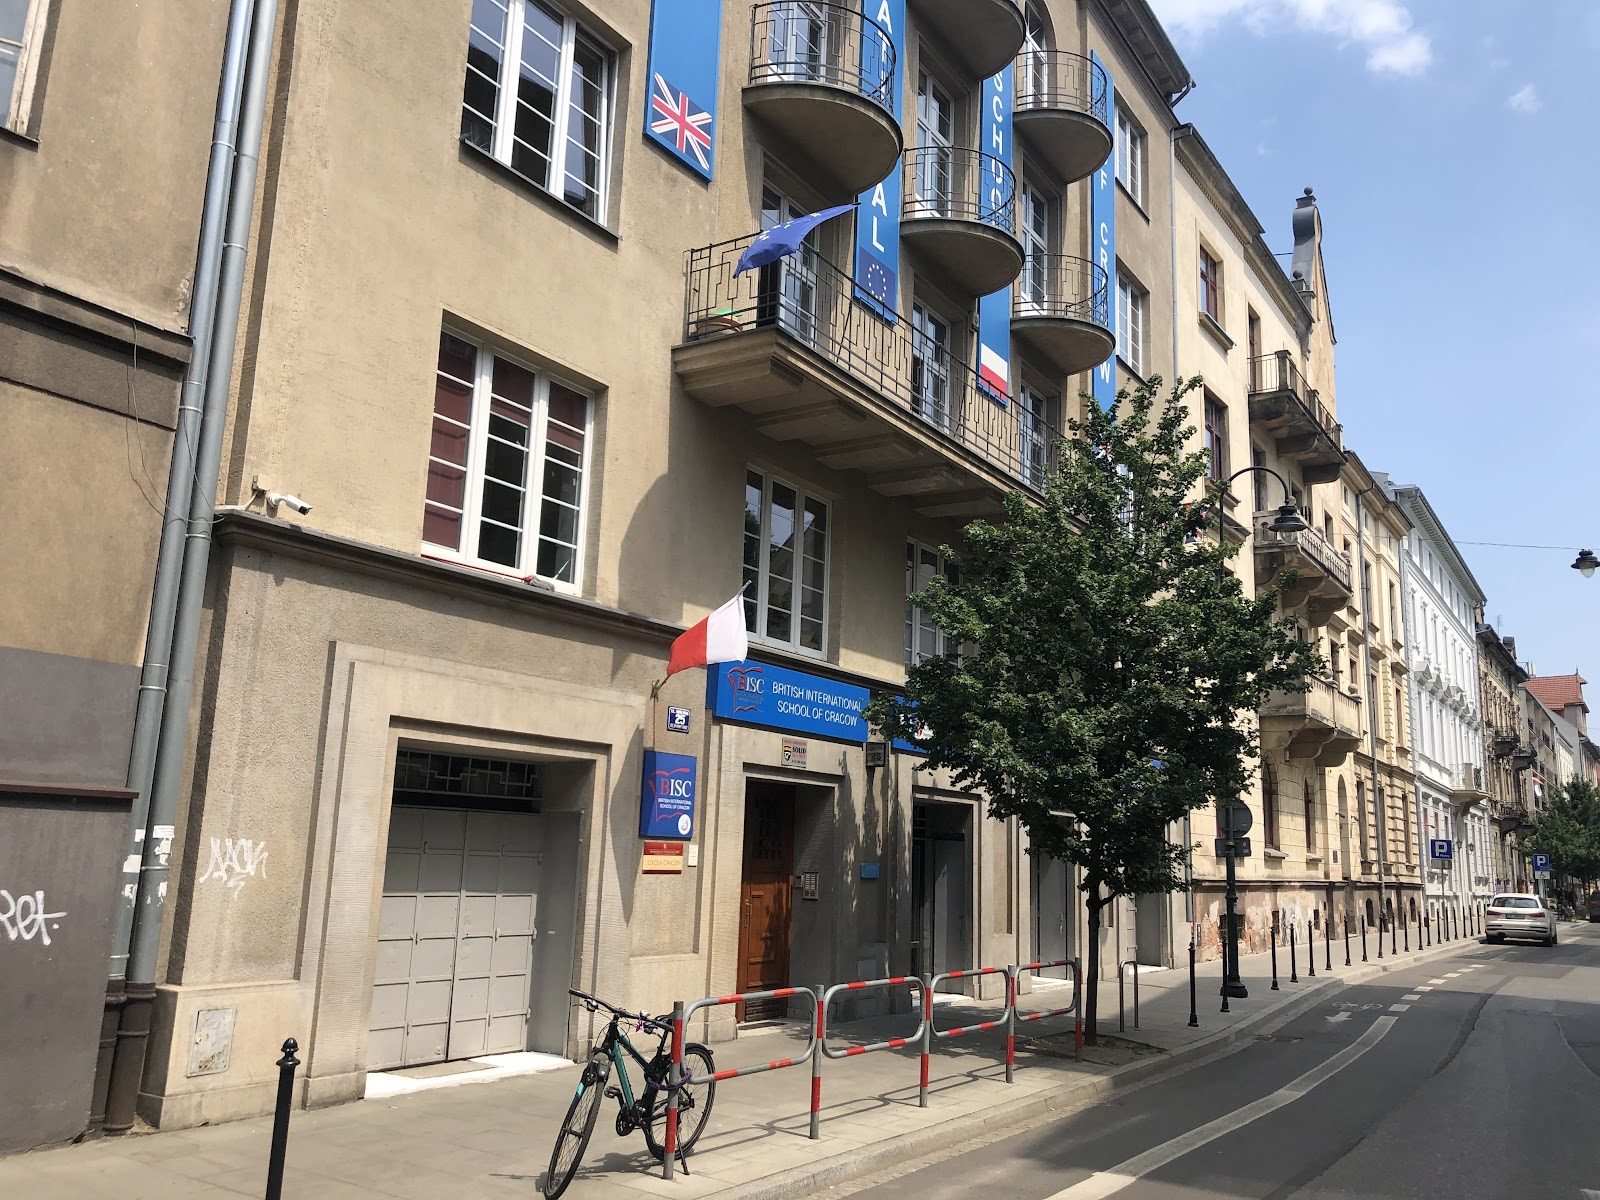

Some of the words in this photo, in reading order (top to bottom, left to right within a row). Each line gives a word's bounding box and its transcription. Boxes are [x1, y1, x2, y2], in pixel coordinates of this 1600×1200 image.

[737, 675, 765, 695] BISC
[772, 681, 804, 699] BRITISH
[805, 689, 863, 713] INTERNATIONAL
[674, 713, 686, 725] 25
[777, 700, 811, 718] SCHOOL
[813, 708, 823, 720] OF
[824, 710, 858, 727] CRACOW
[660, 778, 692, 798] BISC
[1435, 841, 1448, 857] P
[1536, 855, 1546, 867] P
